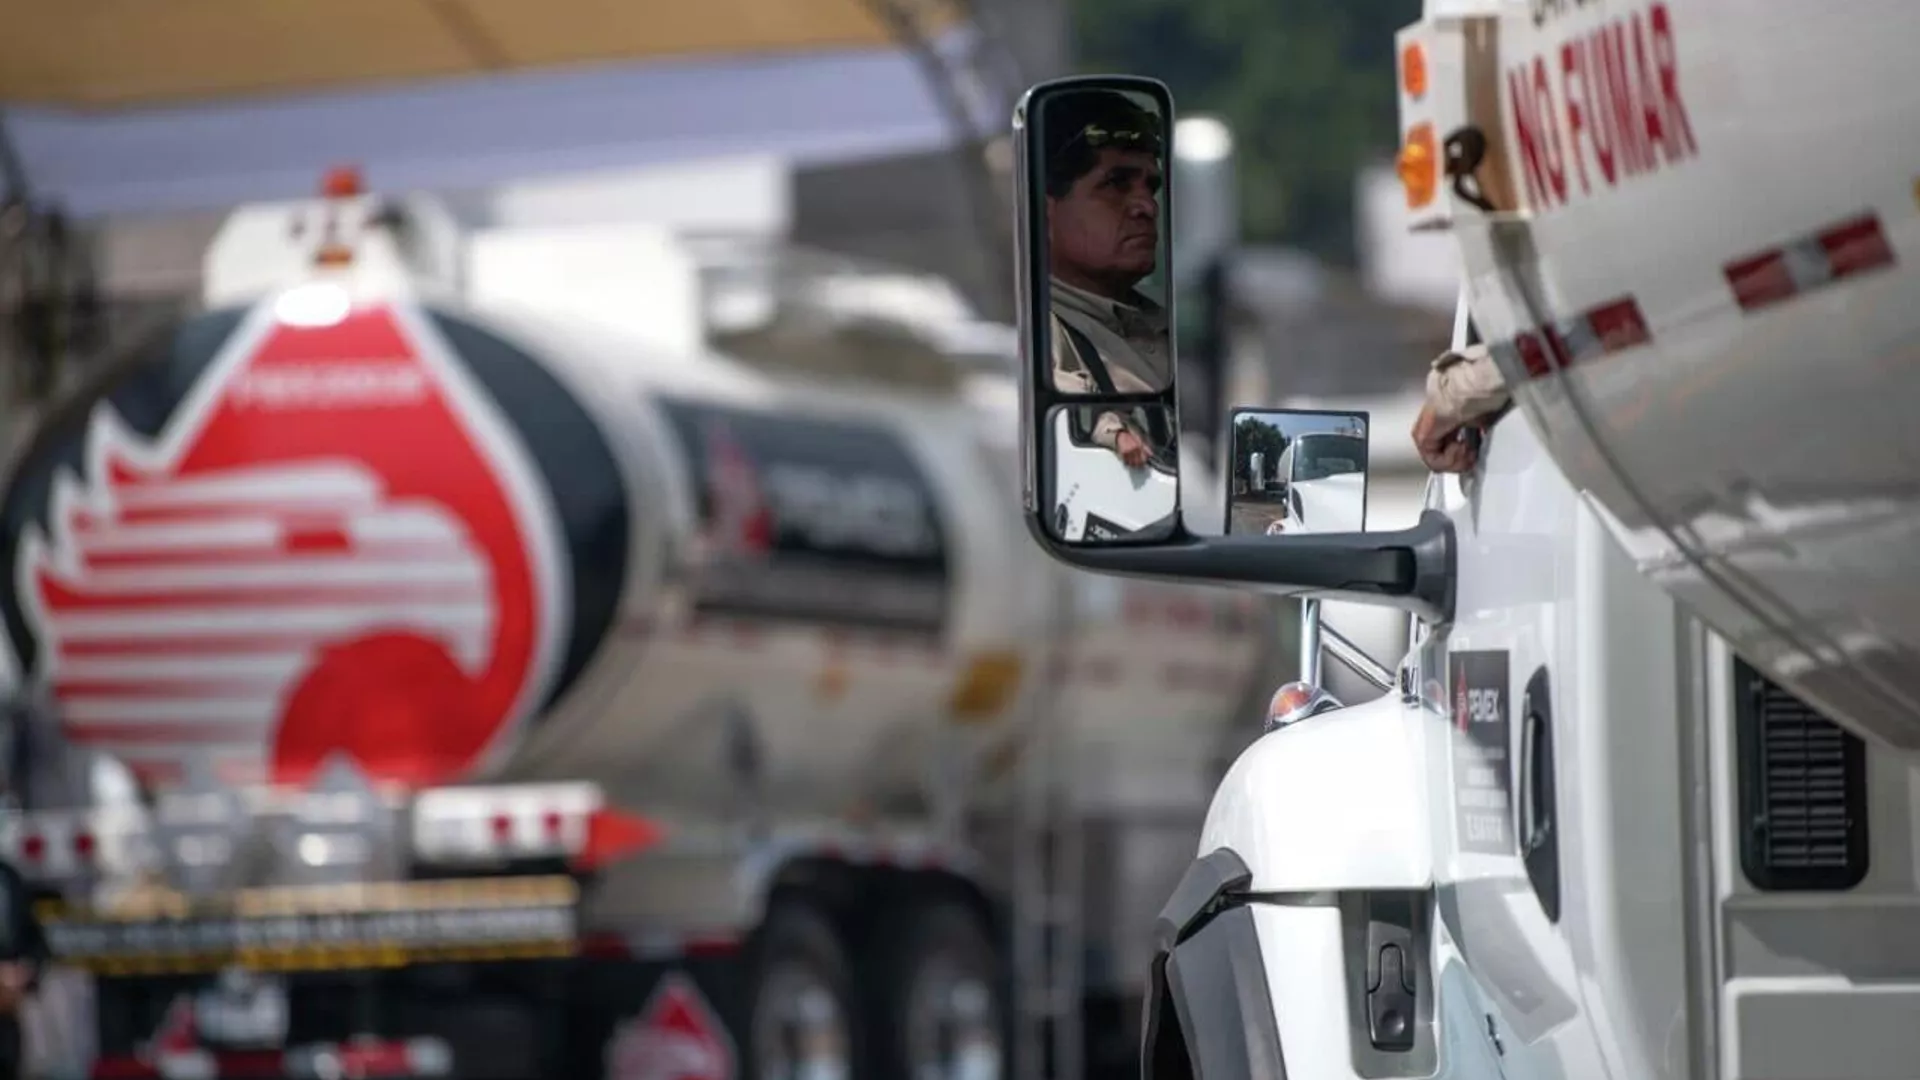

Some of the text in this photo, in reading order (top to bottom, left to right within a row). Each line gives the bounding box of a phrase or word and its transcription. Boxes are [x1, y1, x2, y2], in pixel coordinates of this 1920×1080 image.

[1507, 4, 1697, 211] NO FUMAR
[1468, 687, 1500, 722] PEMEX
